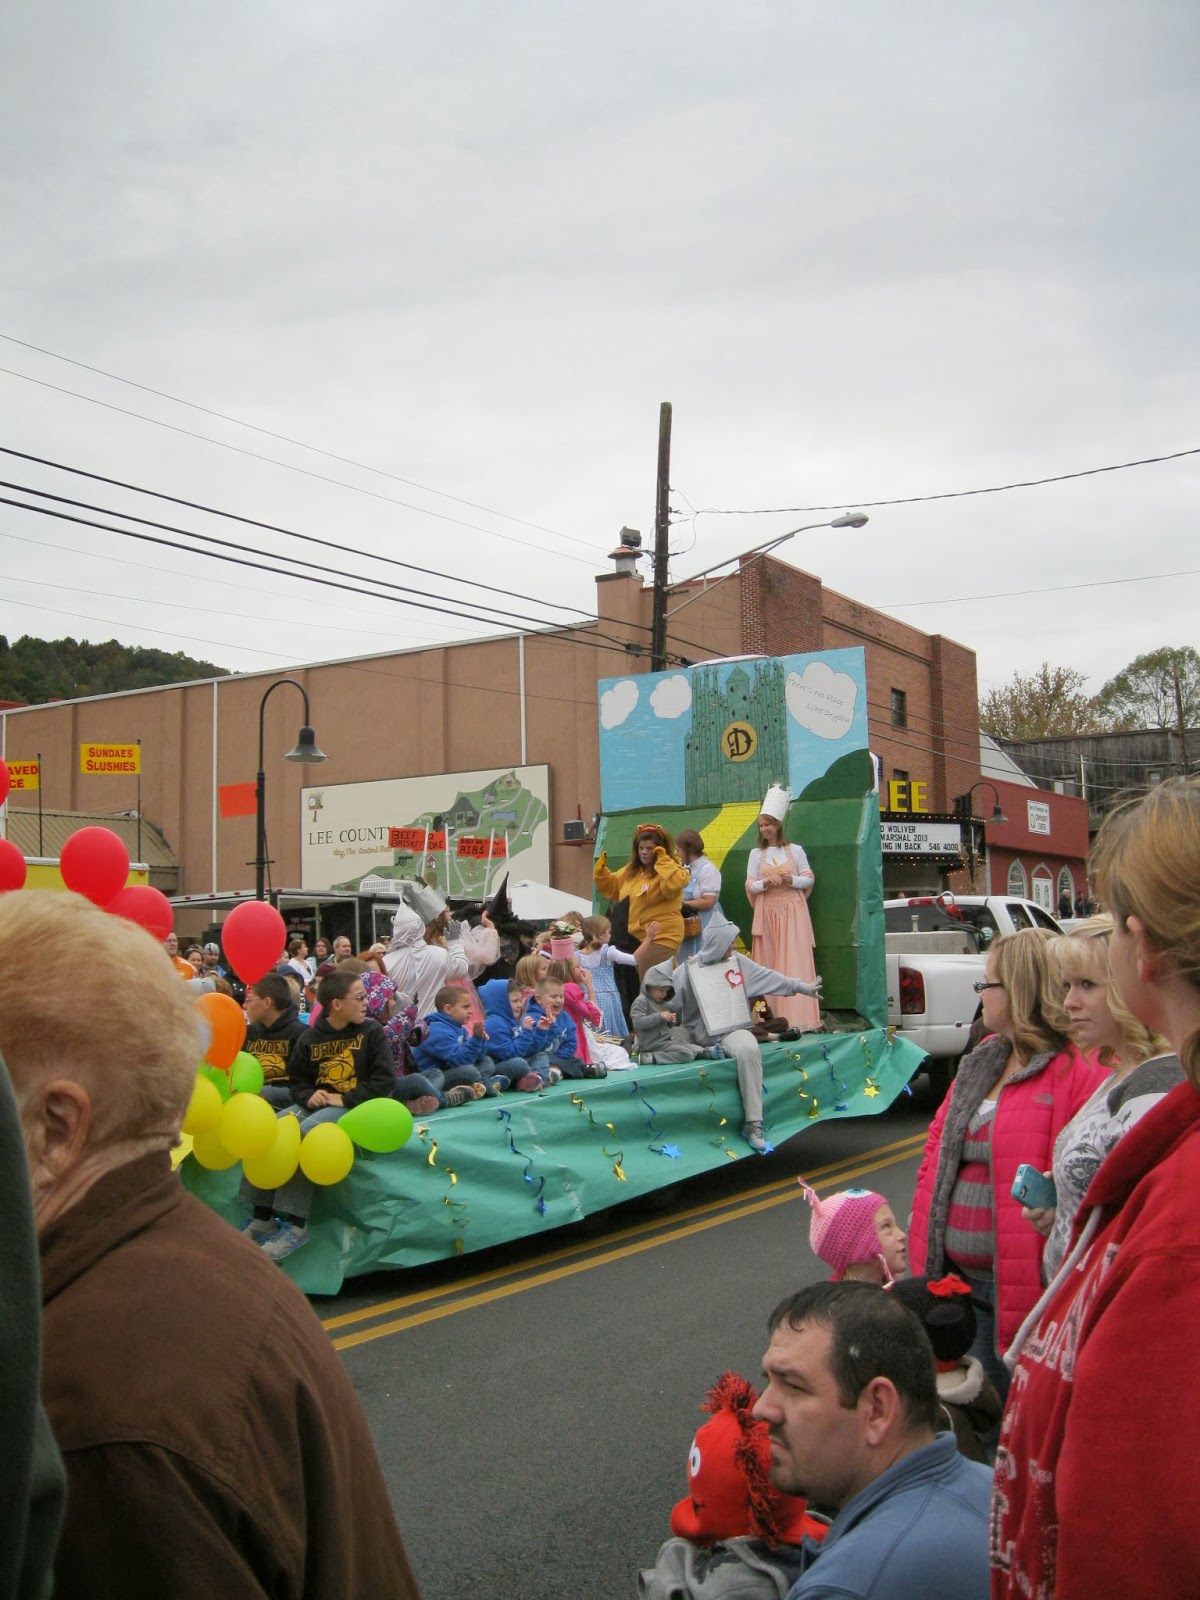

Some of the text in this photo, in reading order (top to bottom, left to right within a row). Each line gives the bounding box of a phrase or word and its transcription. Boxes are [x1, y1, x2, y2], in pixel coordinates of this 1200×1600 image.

[727, 727, 753, 759] D
[88, 747, 133, 758] SUNDAES
[8, 765, 38, 775] AVED
[86, 760, 136, 772] SLUSHIES
[888, 825, 916, 834] WOLIVER
[308, 826, 390, 845] LEE COUNT
[880, 834, 928, 842] MARSHAL 2013
[460, 845, 485, 855] RIBS
[894, 842, 902, 850] IN
[904, 842, 922, 851] BACK
[928, 842, 941, 851] 546
